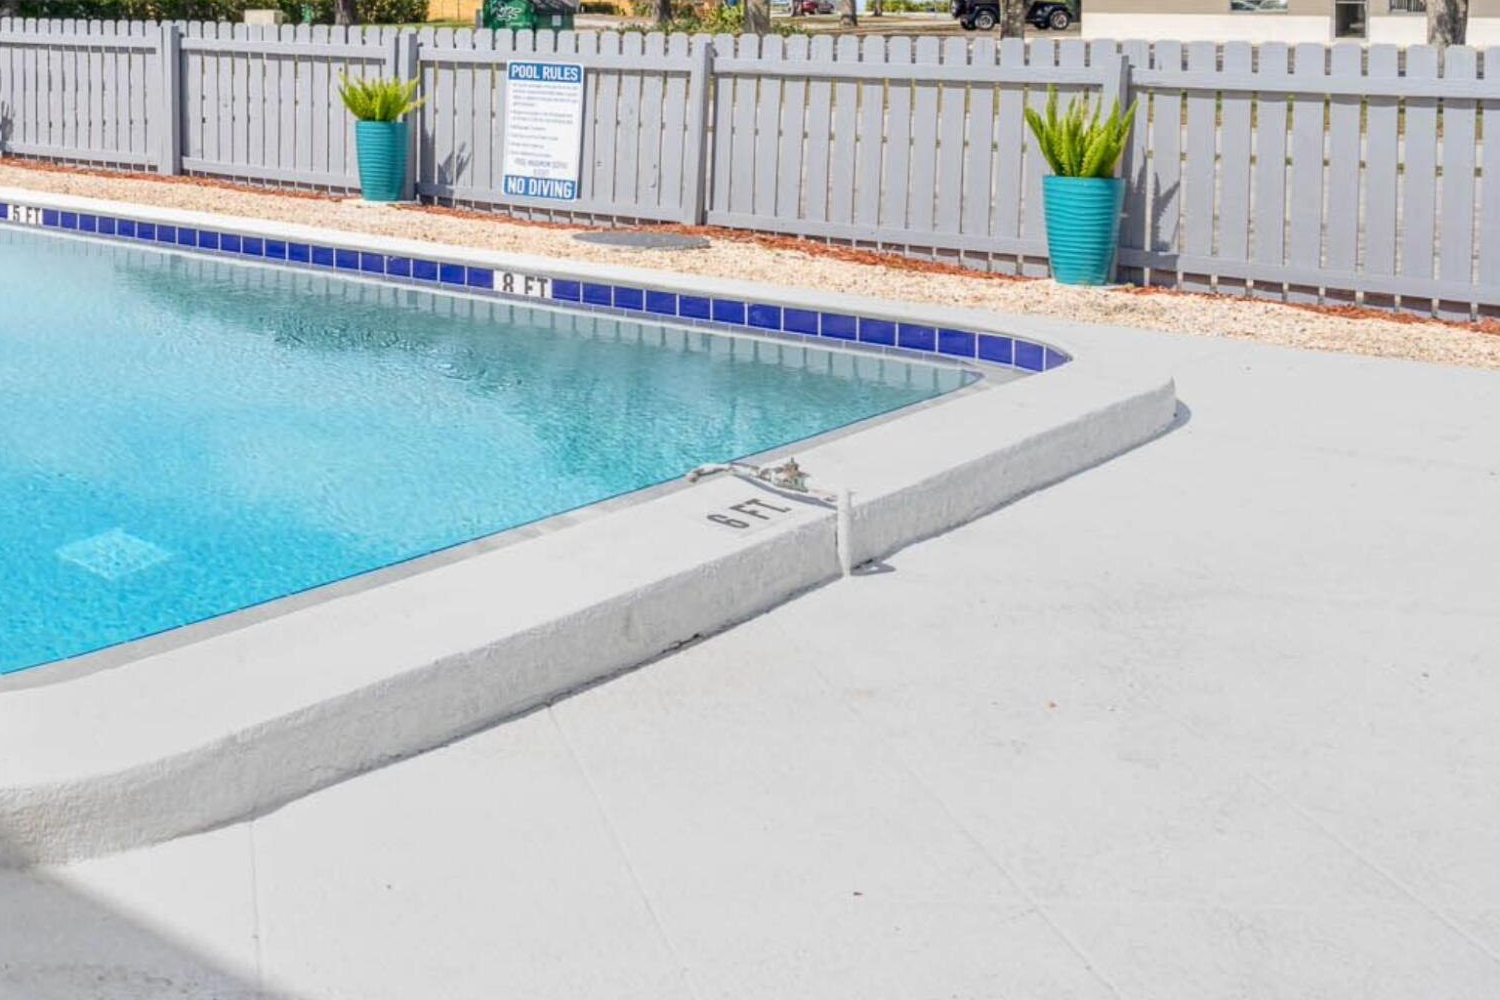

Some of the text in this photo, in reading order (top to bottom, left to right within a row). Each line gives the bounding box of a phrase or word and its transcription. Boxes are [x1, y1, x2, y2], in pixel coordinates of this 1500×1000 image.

[511, 64, 578, 81] POOL RULES
[508, 177, 572, 199] NO DIVING
[26, 206, 40, 226] FT
[524, 275, 548, 298] FT
[729, 498, 792, 521] FT
